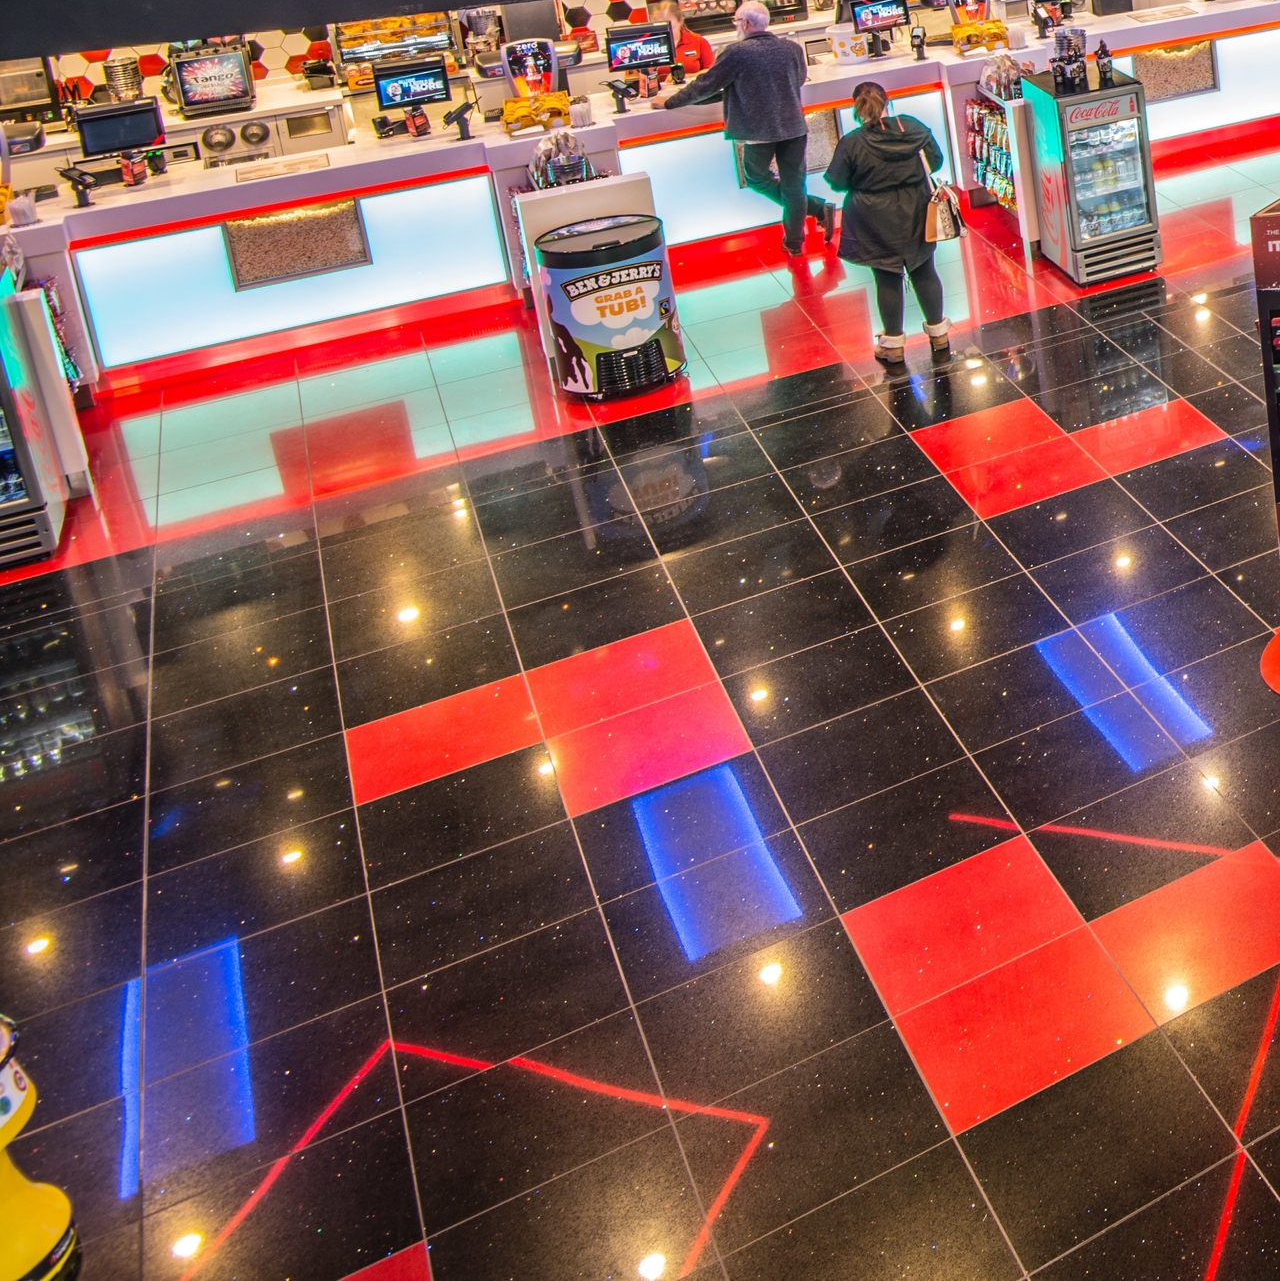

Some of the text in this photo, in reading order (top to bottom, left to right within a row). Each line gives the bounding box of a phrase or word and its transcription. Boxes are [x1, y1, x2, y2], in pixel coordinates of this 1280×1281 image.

[879, 6, 905, 17] MORE
[638, 45, 668, 56] MORE
[190, 72, 234, 84] Tango
[411, 80, 444, 93] MORE
[1069, 98, 1121, 124] Coca-Cola
[566, 263, 661, 298] BEN & JERRY'S
[594, 285, 645, 304] GRAB A
[596, 295, 647, 319] TUB!
